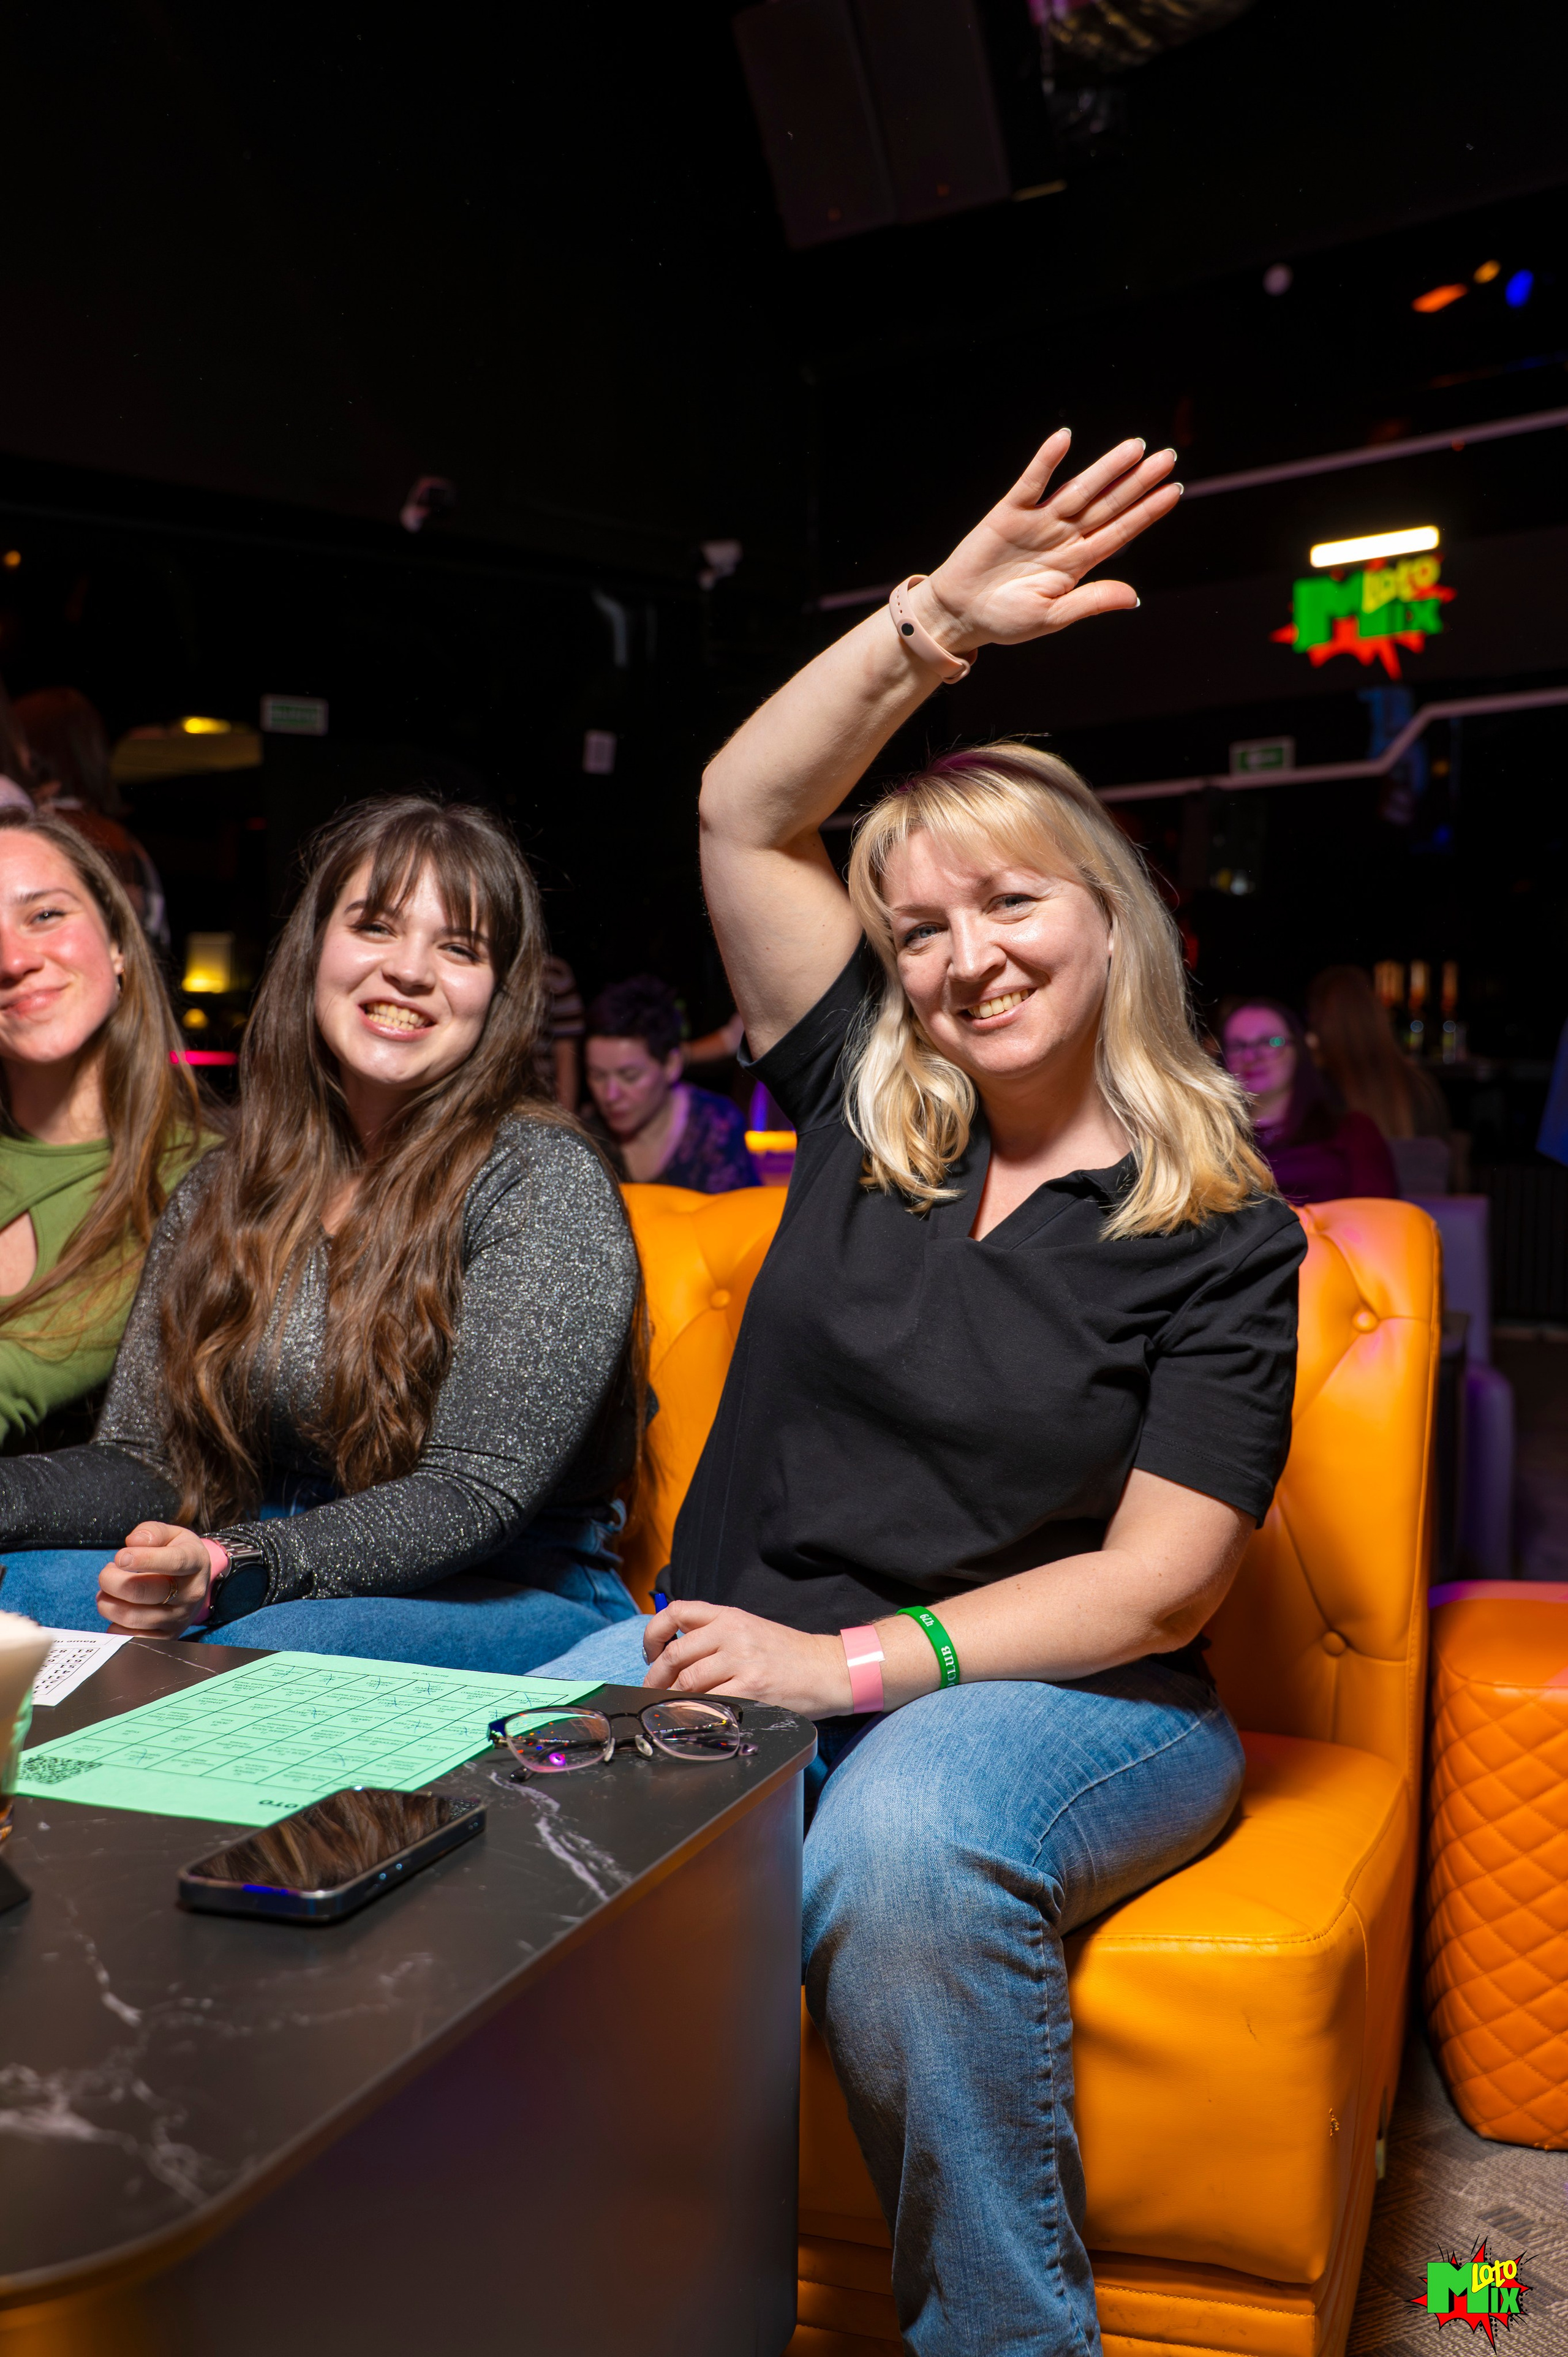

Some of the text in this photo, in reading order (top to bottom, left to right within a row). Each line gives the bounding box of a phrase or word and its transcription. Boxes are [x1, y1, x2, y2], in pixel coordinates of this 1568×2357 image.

[919, 1614, 934, 1627] 479
[941, 1645, 956, 1681] CLUB
[258, 1800, 305, 1810] OTO
